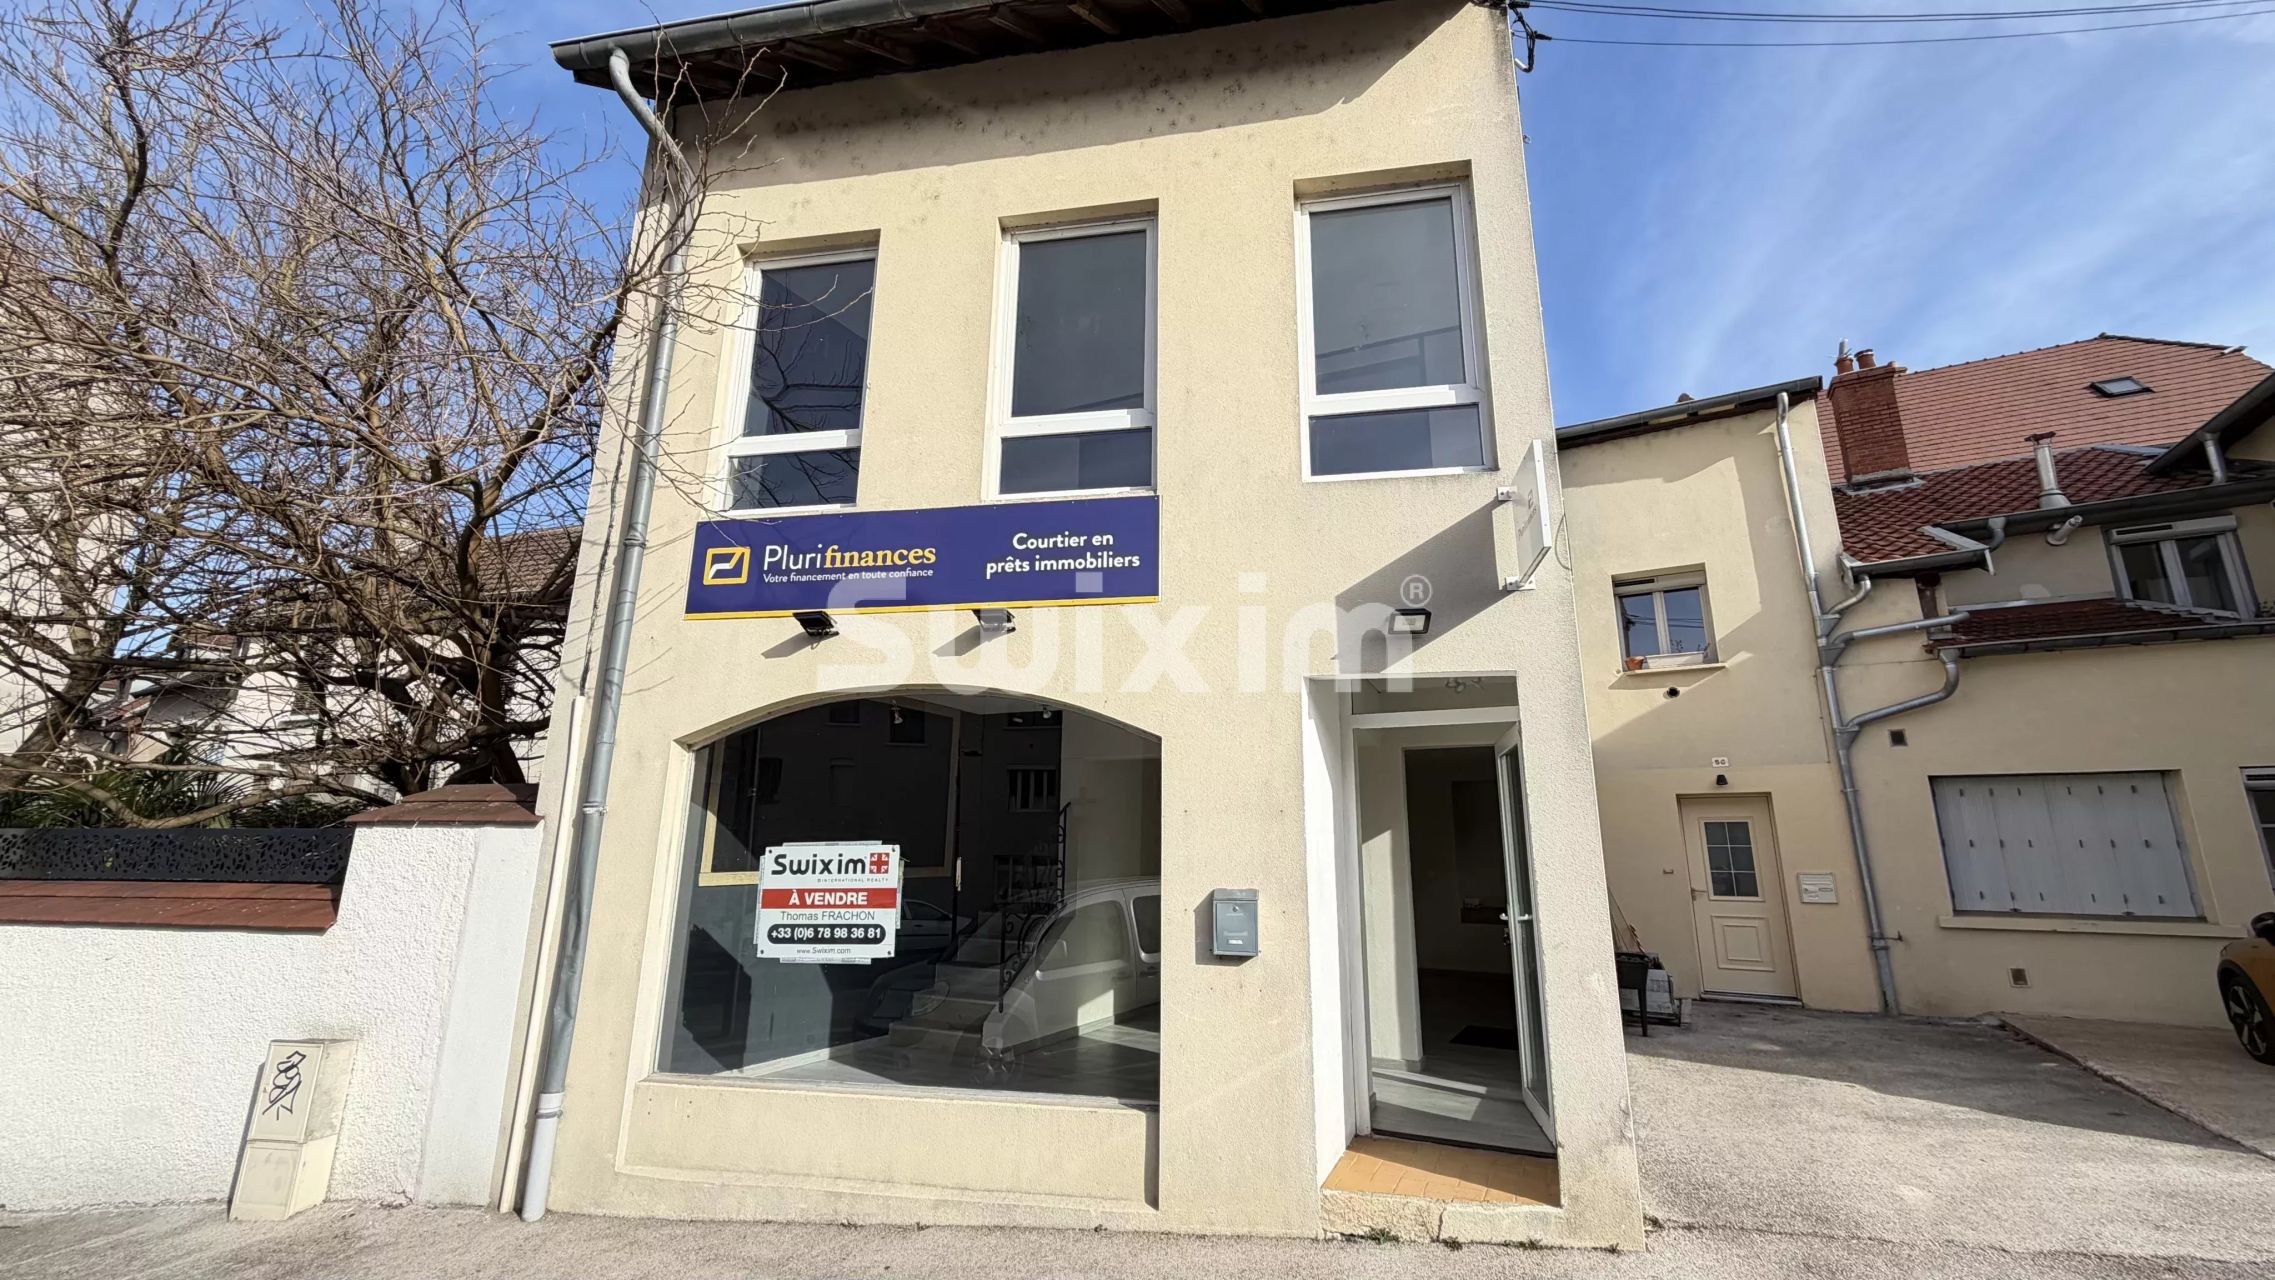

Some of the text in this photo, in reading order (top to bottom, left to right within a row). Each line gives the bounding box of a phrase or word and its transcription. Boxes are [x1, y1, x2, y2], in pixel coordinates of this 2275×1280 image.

[1012, 531, 1114, 550] Courtier en
[763, 543, 937, 571] Plurifinances
[986, 551, 1140, 580] prêts immobiliers
[763, 573, 788, 583] Votre
[790, 572, 846, 582] financement
[862, 571, 887, 579] toute
[889, 567, 934, 578] confiance
[771, 853, 866, 876] Swixim
[788, 890, 868, 905] À VENDRE
[781, 911, 875, 921] Thomas FRACHON
[771, 927, 881, 940] +33 (0)6 78 98 36 81
